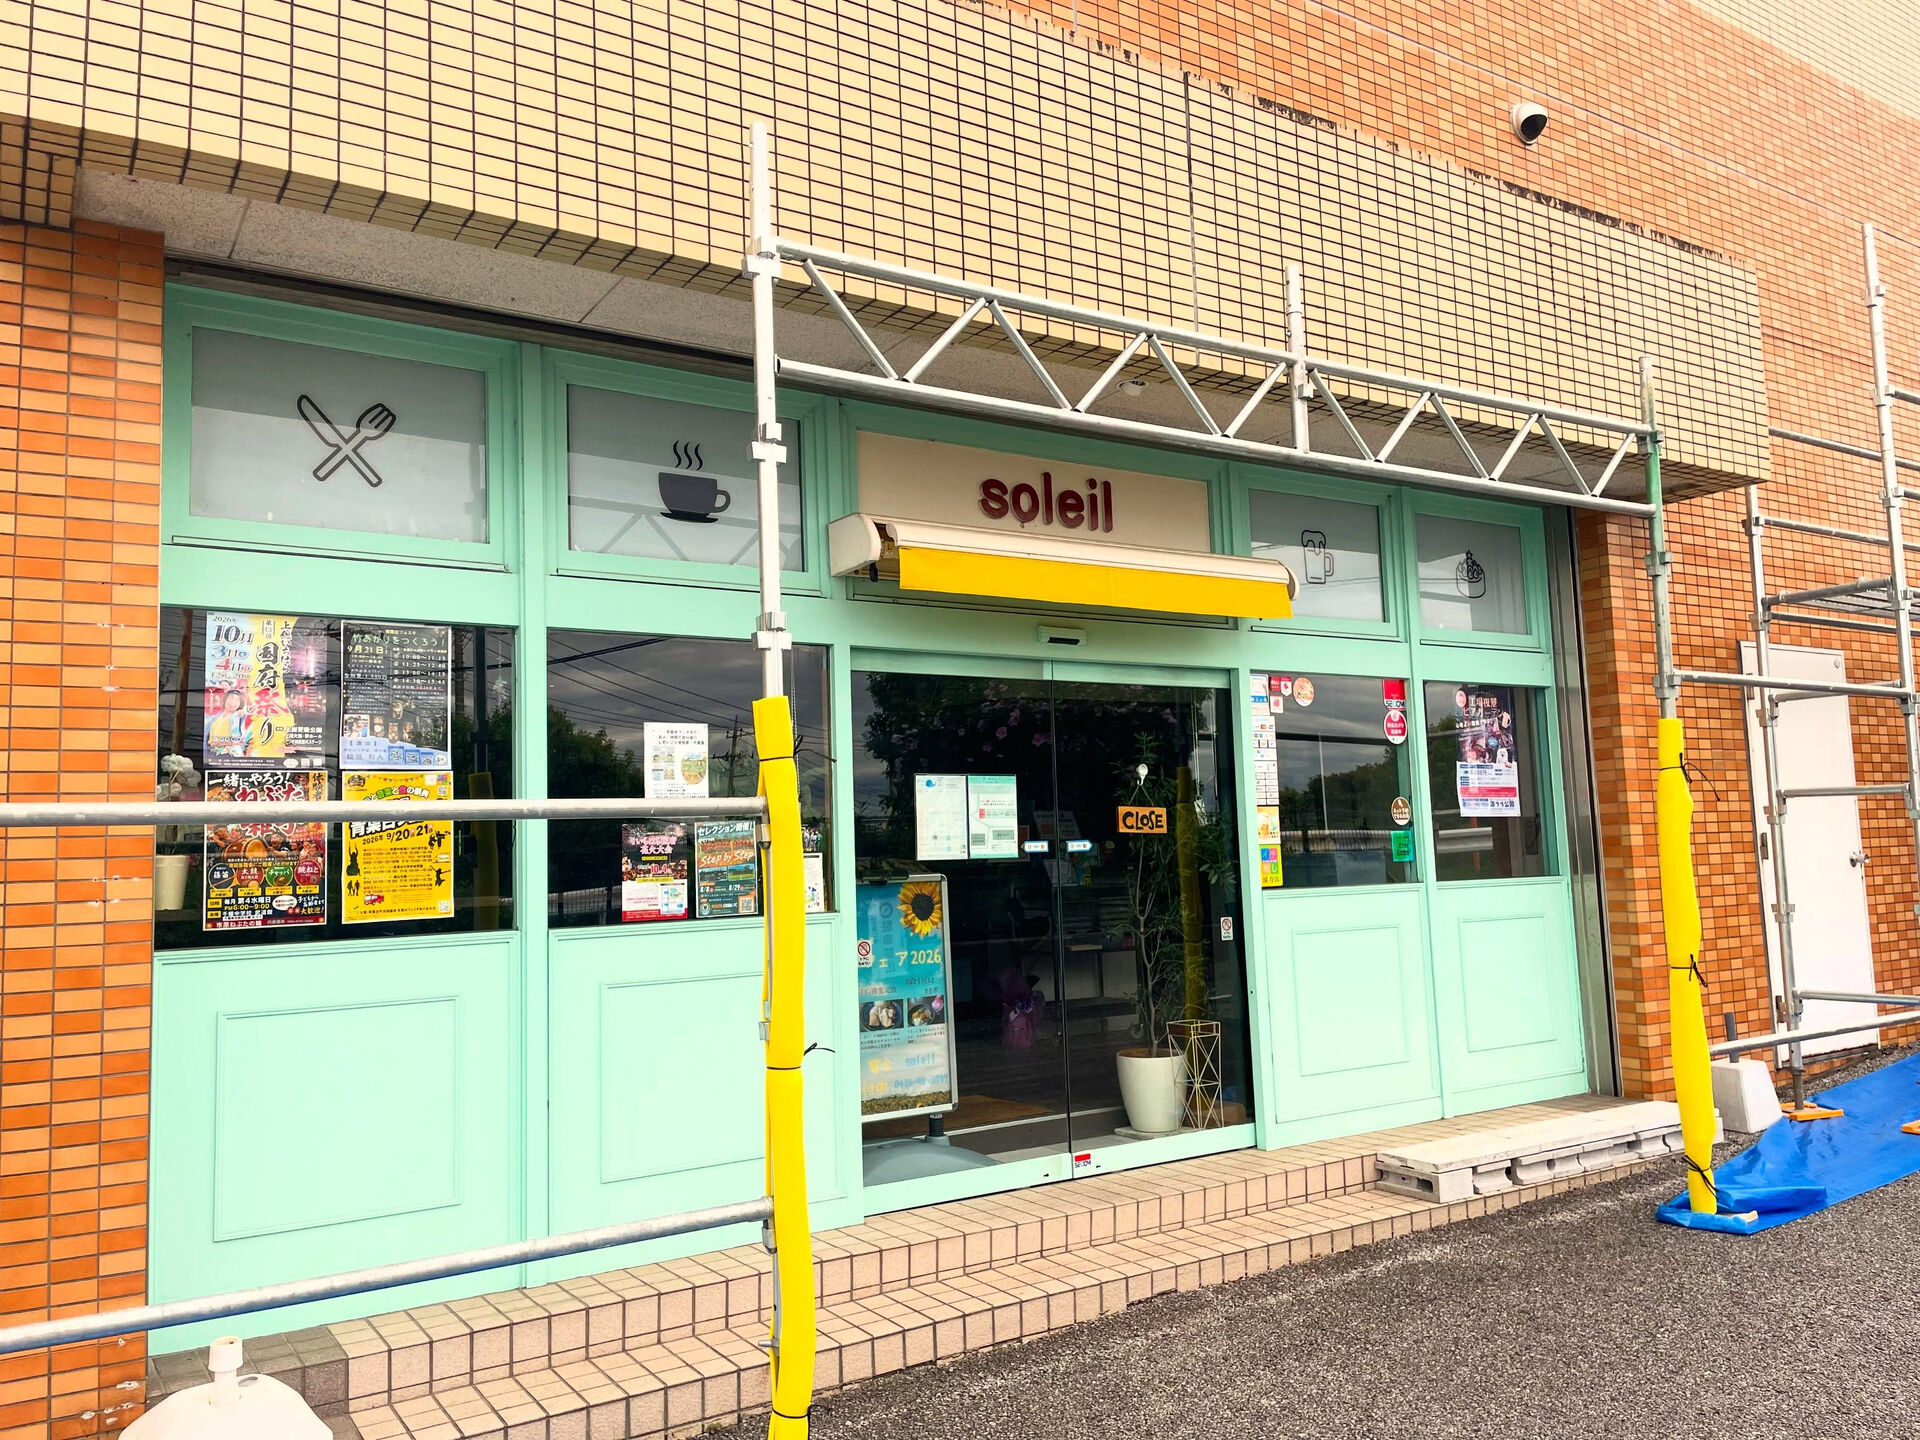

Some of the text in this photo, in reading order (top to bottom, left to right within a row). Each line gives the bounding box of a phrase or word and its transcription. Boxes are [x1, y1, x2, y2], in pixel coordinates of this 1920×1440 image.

[979, 471, 1113, 533] soleil
[214, 625, 253, 643] 10月
[347, 645, 383, 654] 9月21日
[253, 641, 290, 745] 国府祭り
[209, 772, 290, 788] 一緒にやろう!
[1122, 811, 1164, 830] CLOSE
[699, 849, 754, 868] Step by Step
[301, 907, 325, 915] 大歓迎!
